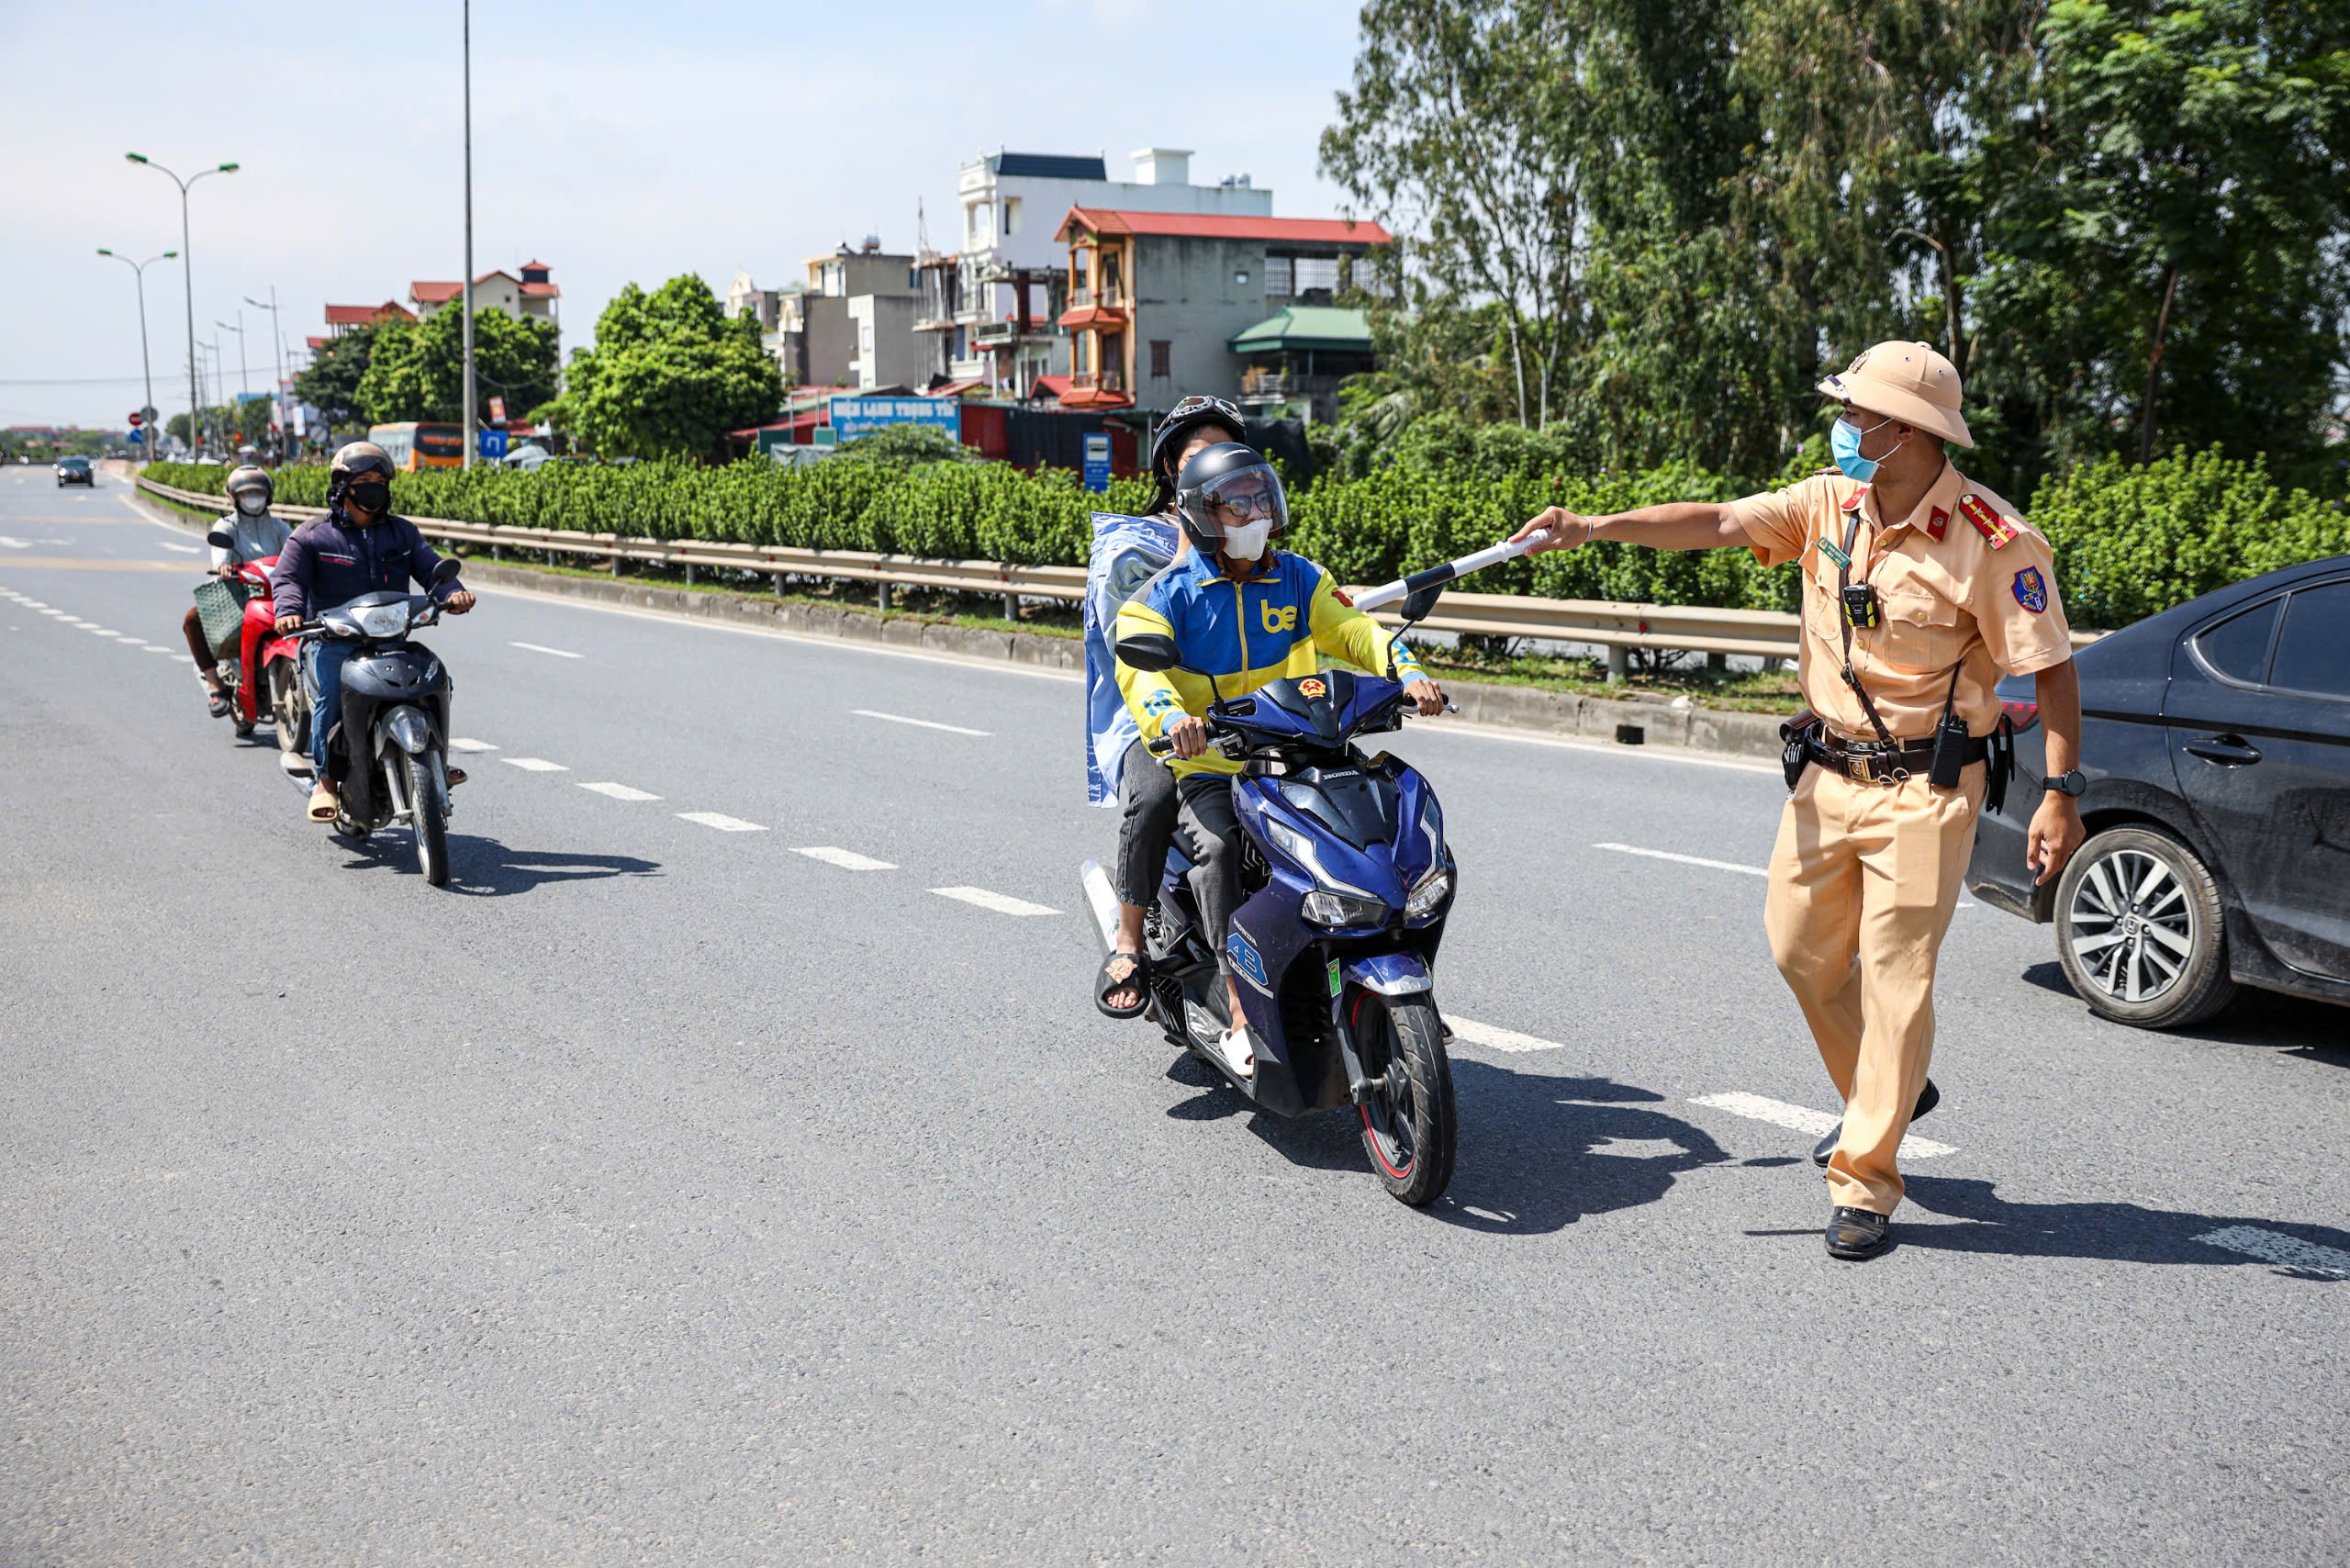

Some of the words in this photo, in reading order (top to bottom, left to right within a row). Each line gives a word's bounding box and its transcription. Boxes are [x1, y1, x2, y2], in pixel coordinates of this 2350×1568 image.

[1260, 599, 1297, 633] be
[1323, 770, 1360, 780] HONDA
[1233, 916, 1259, 946] HONDA
